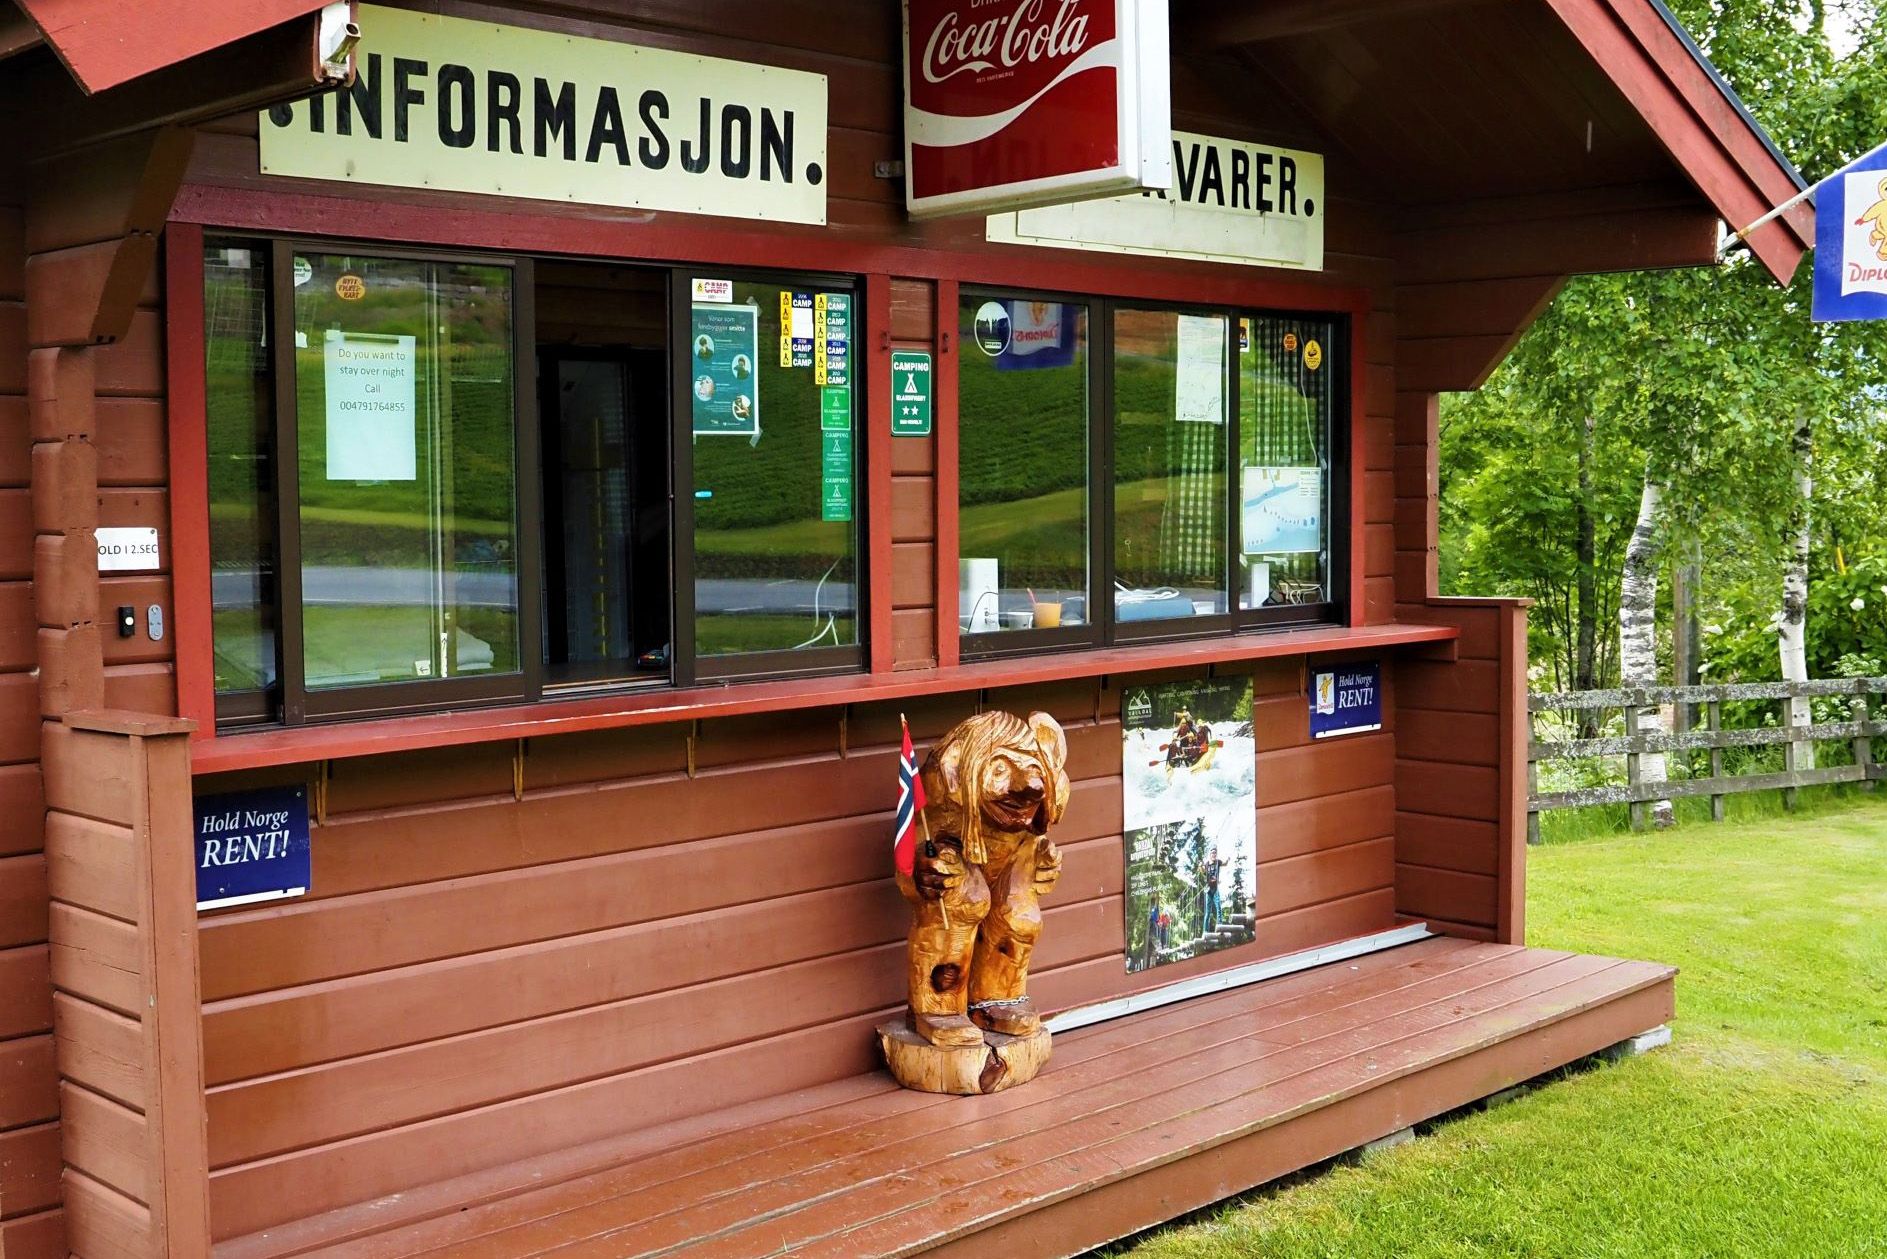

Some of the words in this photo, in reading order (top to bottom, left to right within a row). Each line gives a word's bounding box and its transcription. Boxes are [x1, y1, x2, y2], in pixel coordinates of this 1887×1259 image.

[922, 0, 1089, 83] Coca-Cola
[793, 299, 812, 308] CAMP
[827, 303, 846, 311] CAMP
[827, 317, 846, 326] CAMP
[827, 332, 846, 341] CAMP
[793, 344, 812, 352] CAMP
[827, 347, 846, 355] CAMP
[338, 348, 352, 358] Do
[353, 351, 370, 360] you
[372, 351, 394, 360] want
[396, 352, 406, 360] to
[793, 359, 812, 367] CAMP
[827, 361, 846, 370] CAMP
[893, 361, 929, 372] CAMPING
[339, 366, 358, 376] stay
[382, 367, 405, 379] night
[827, 376, 846, 384] CAMP
[364, 383, 381, 393] Call
[339, 401, 405, 412] 004791764855
[1338, 673, 1354, 687] Hold
[1355, 673, 1373, 687] Norge
[1338, 687, 1374, 709] RENT!
[201, 811, 241, 834] Hold
[243, 810, 289, 830] Norge
[200, 829, 290, 868] RENT!
